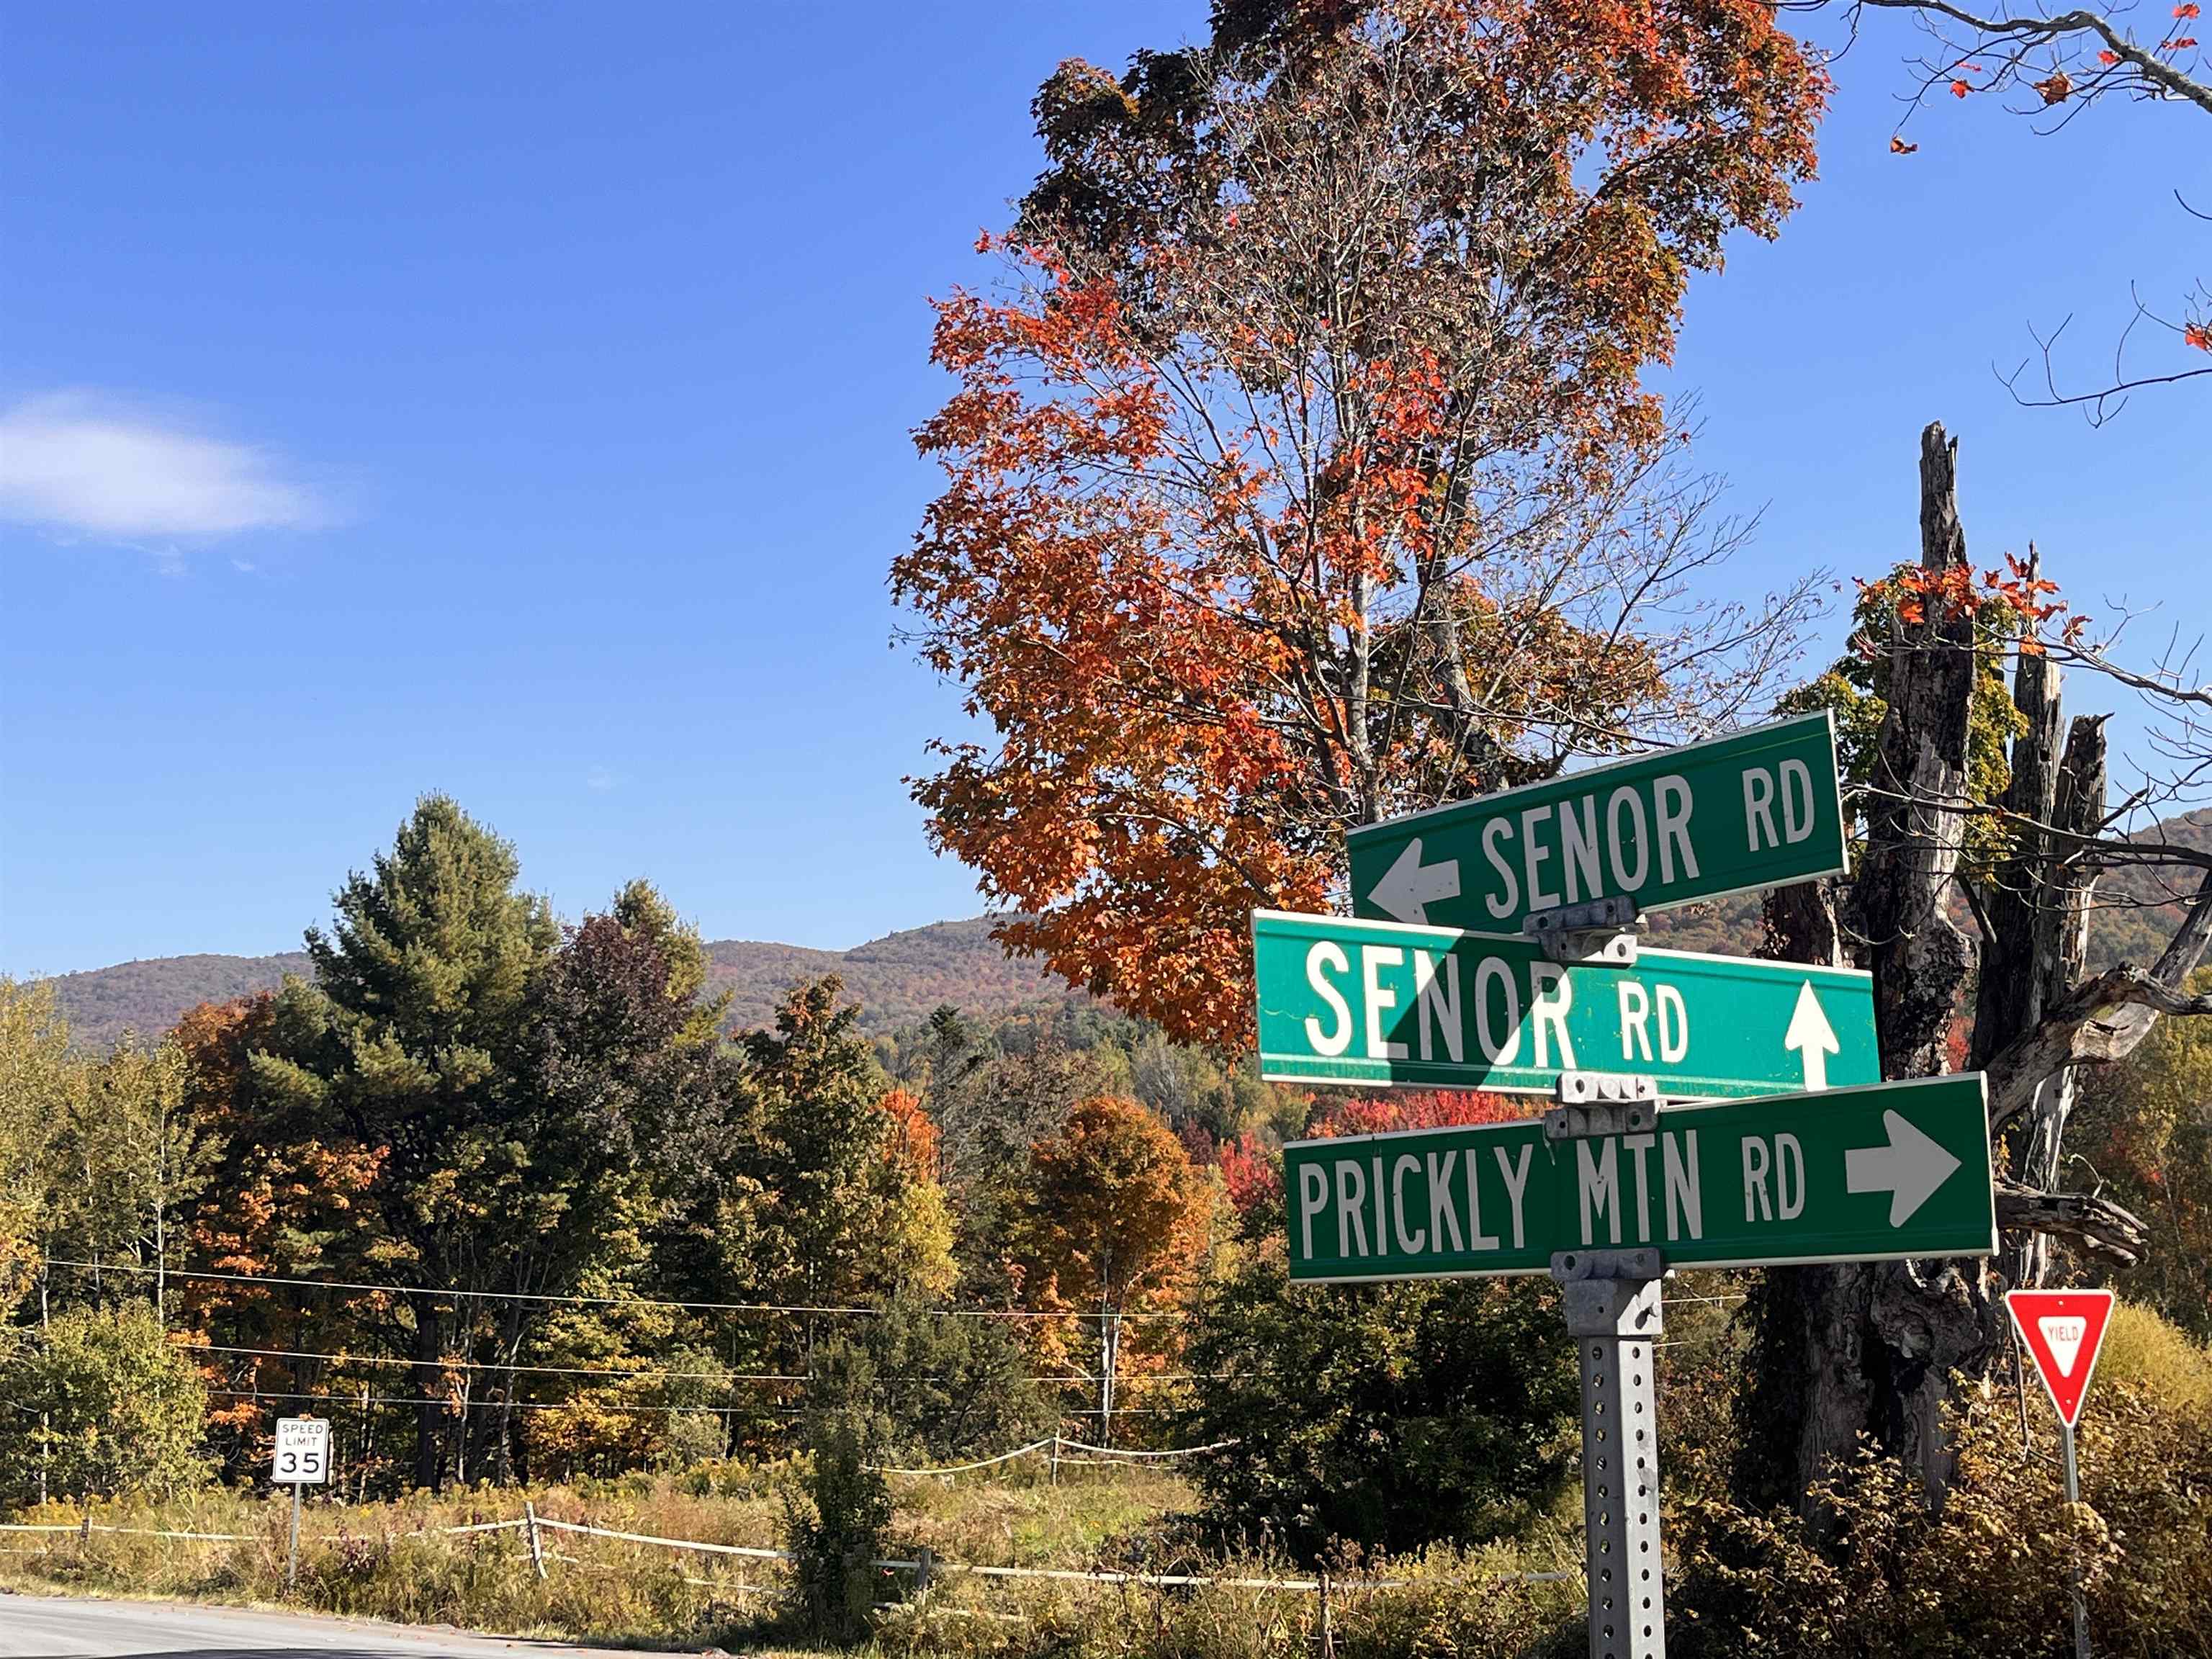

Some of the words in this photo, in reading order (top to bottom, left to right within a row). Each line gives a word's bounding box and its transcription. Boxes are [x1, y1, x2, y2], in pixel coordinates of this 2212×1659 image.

[1483, 774, 1700, 920] SENOR
[1742, 758, 1815, 853] RD
[1305, 940, 1576, 1069] SENOR
[1618, 979, 1689, 1064] RD
[1299, 1143, 1533, 1260] PRICKLY
[1578, 1129, 1703, 1246] MTN
[1740, 1132, 1806, 1222] RD
[2049, 1326, 2078, 1341] YIELD
[283, 1424, 323, 1434] SPEED
[286, 1437, 317, 1446] LIMIT
[281, 1452, 319, 1473] 35
